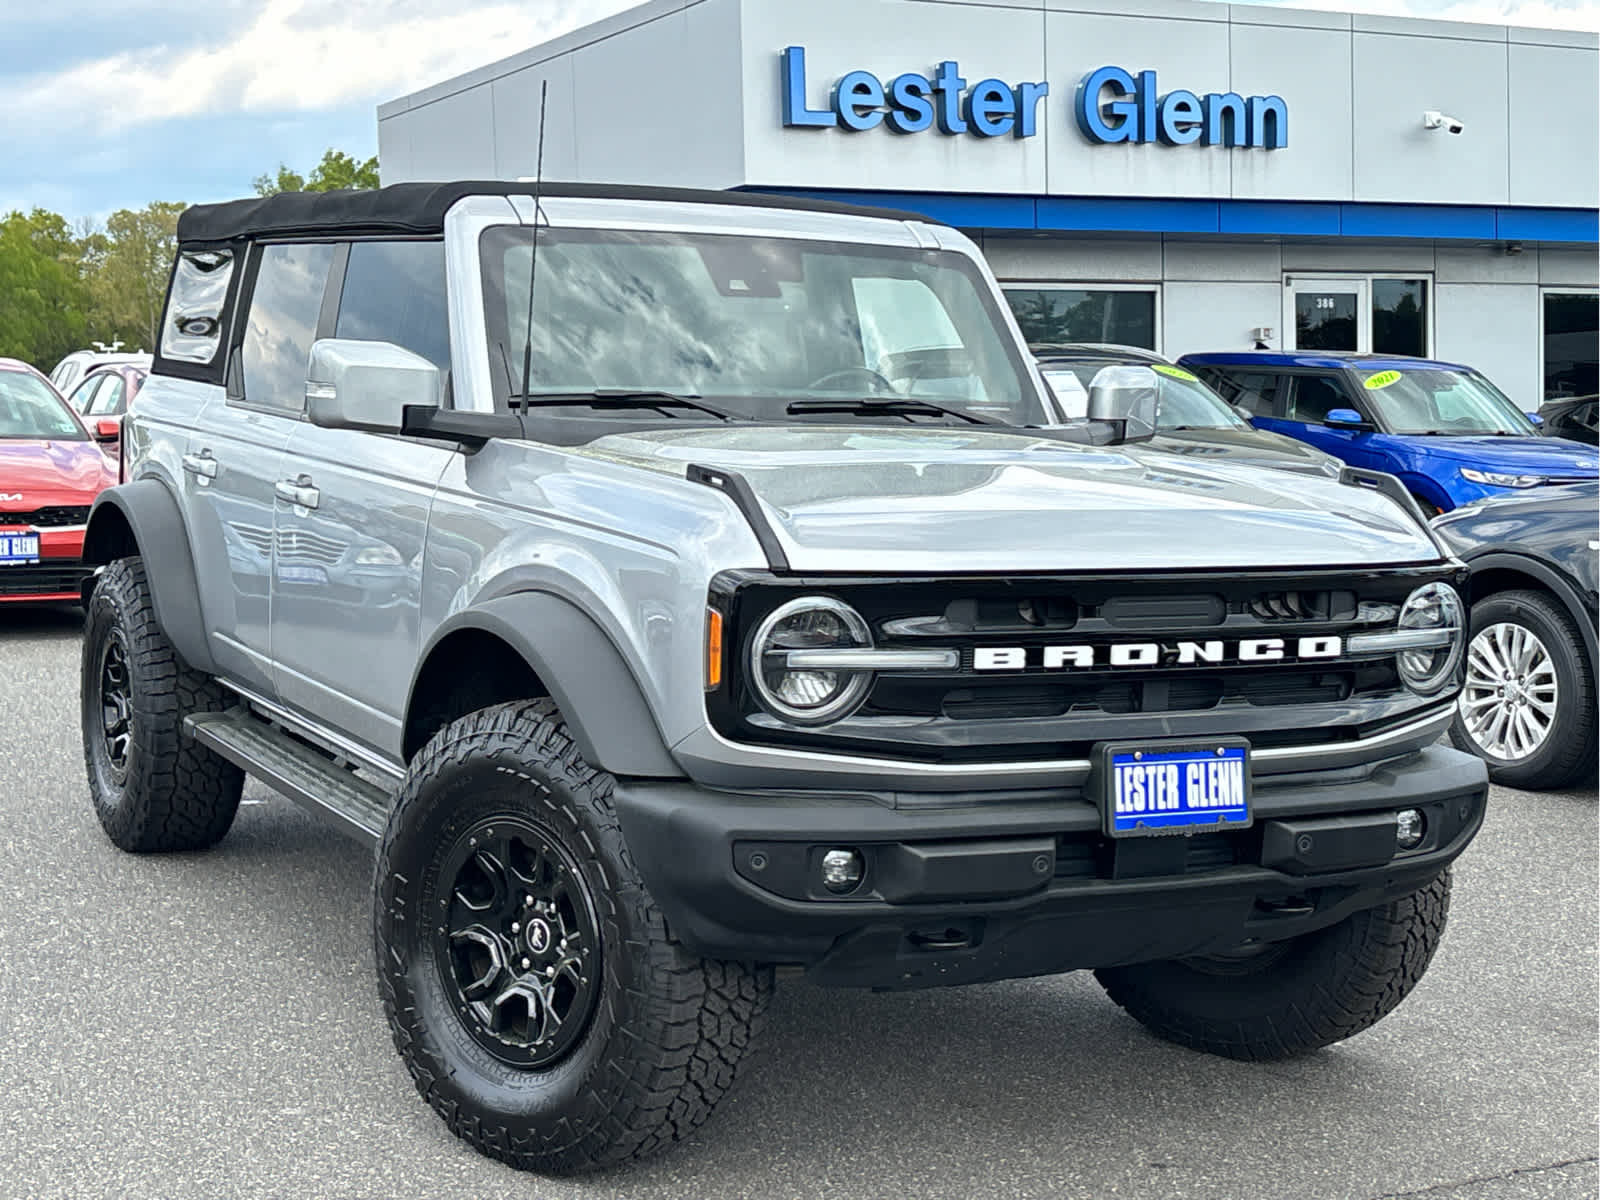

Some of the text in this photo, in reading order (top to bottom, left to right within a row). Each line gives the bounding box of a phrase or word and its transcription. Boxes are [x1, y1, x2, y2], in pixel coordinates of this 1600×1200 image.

[781, 46, 1288, 149] Lester Glenn
[973, 636, 1342, 670] BRONCO
[1114, 761, 1244, 812] LESTER GLENN
